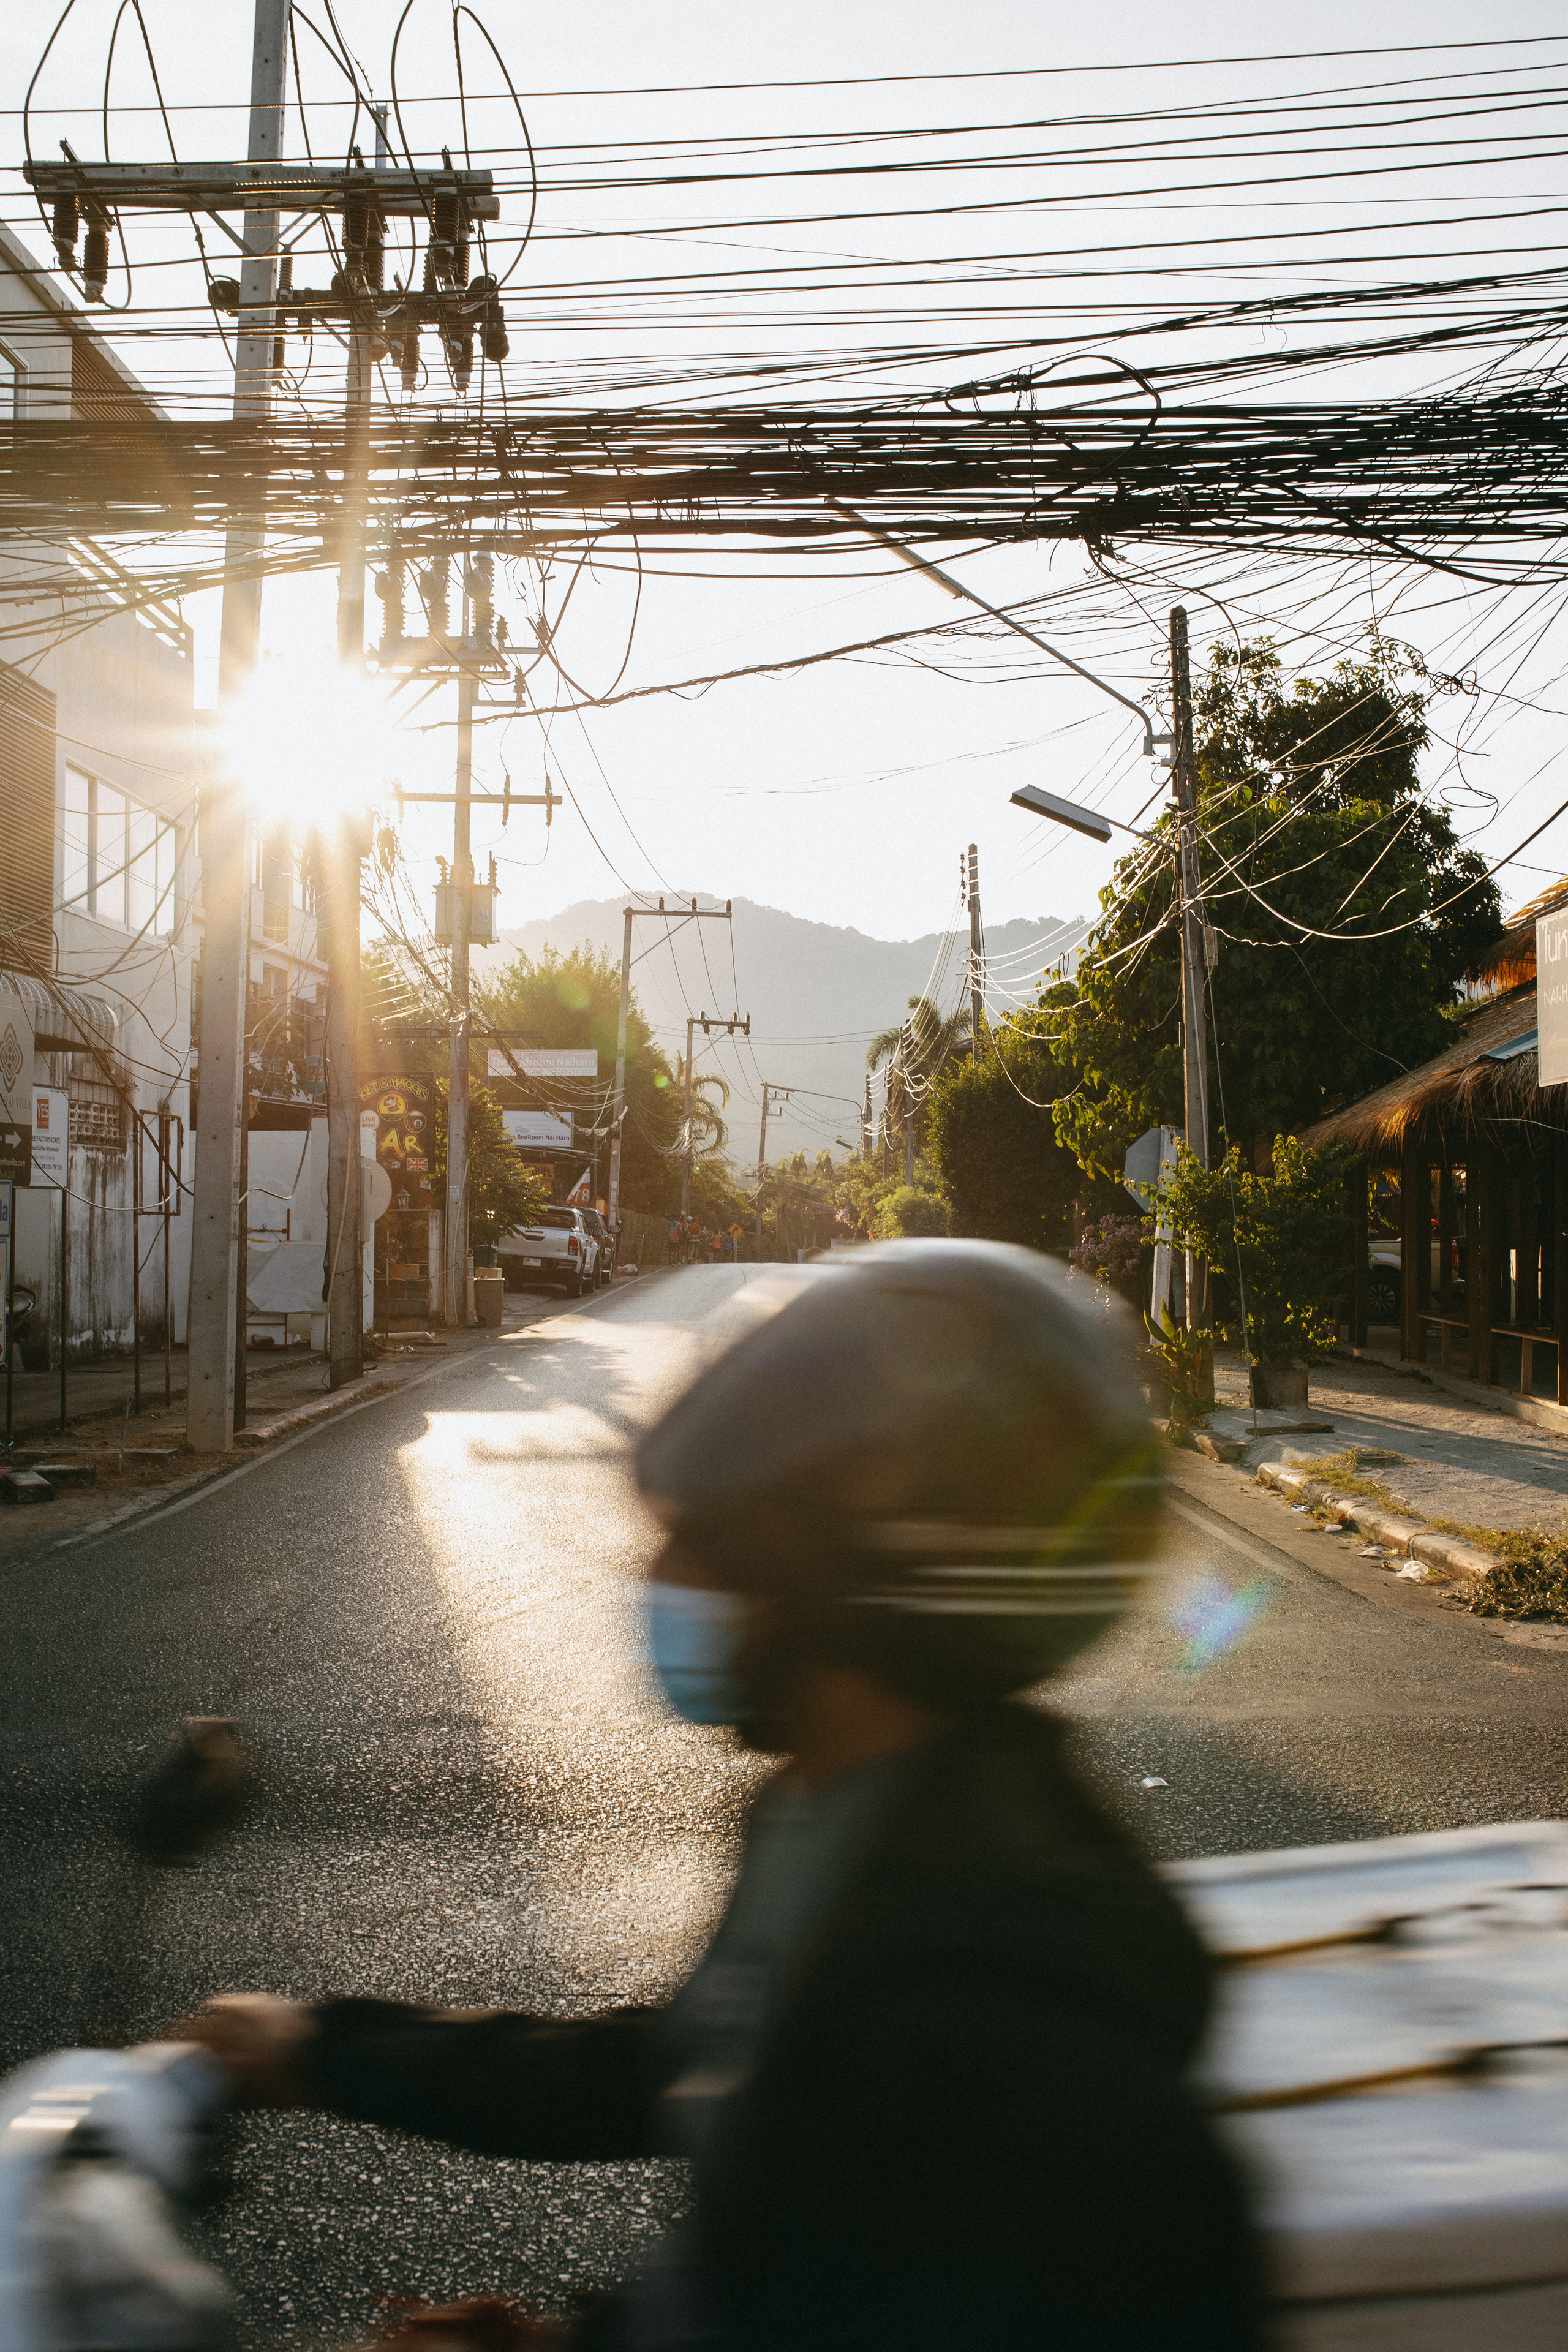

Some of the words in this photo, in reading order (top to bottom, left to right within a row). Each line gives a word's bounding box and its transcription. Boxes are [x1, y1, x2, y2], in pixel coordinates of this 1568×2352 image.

[557, 1057, 595, 1066] Naiharn
[380, 1078, 390, 1089] &
[391, 1077, 428, 1101] HAGGIS
[37, 1103, 49, 1118] YES
[380, 1129, 424, 1159] AR
